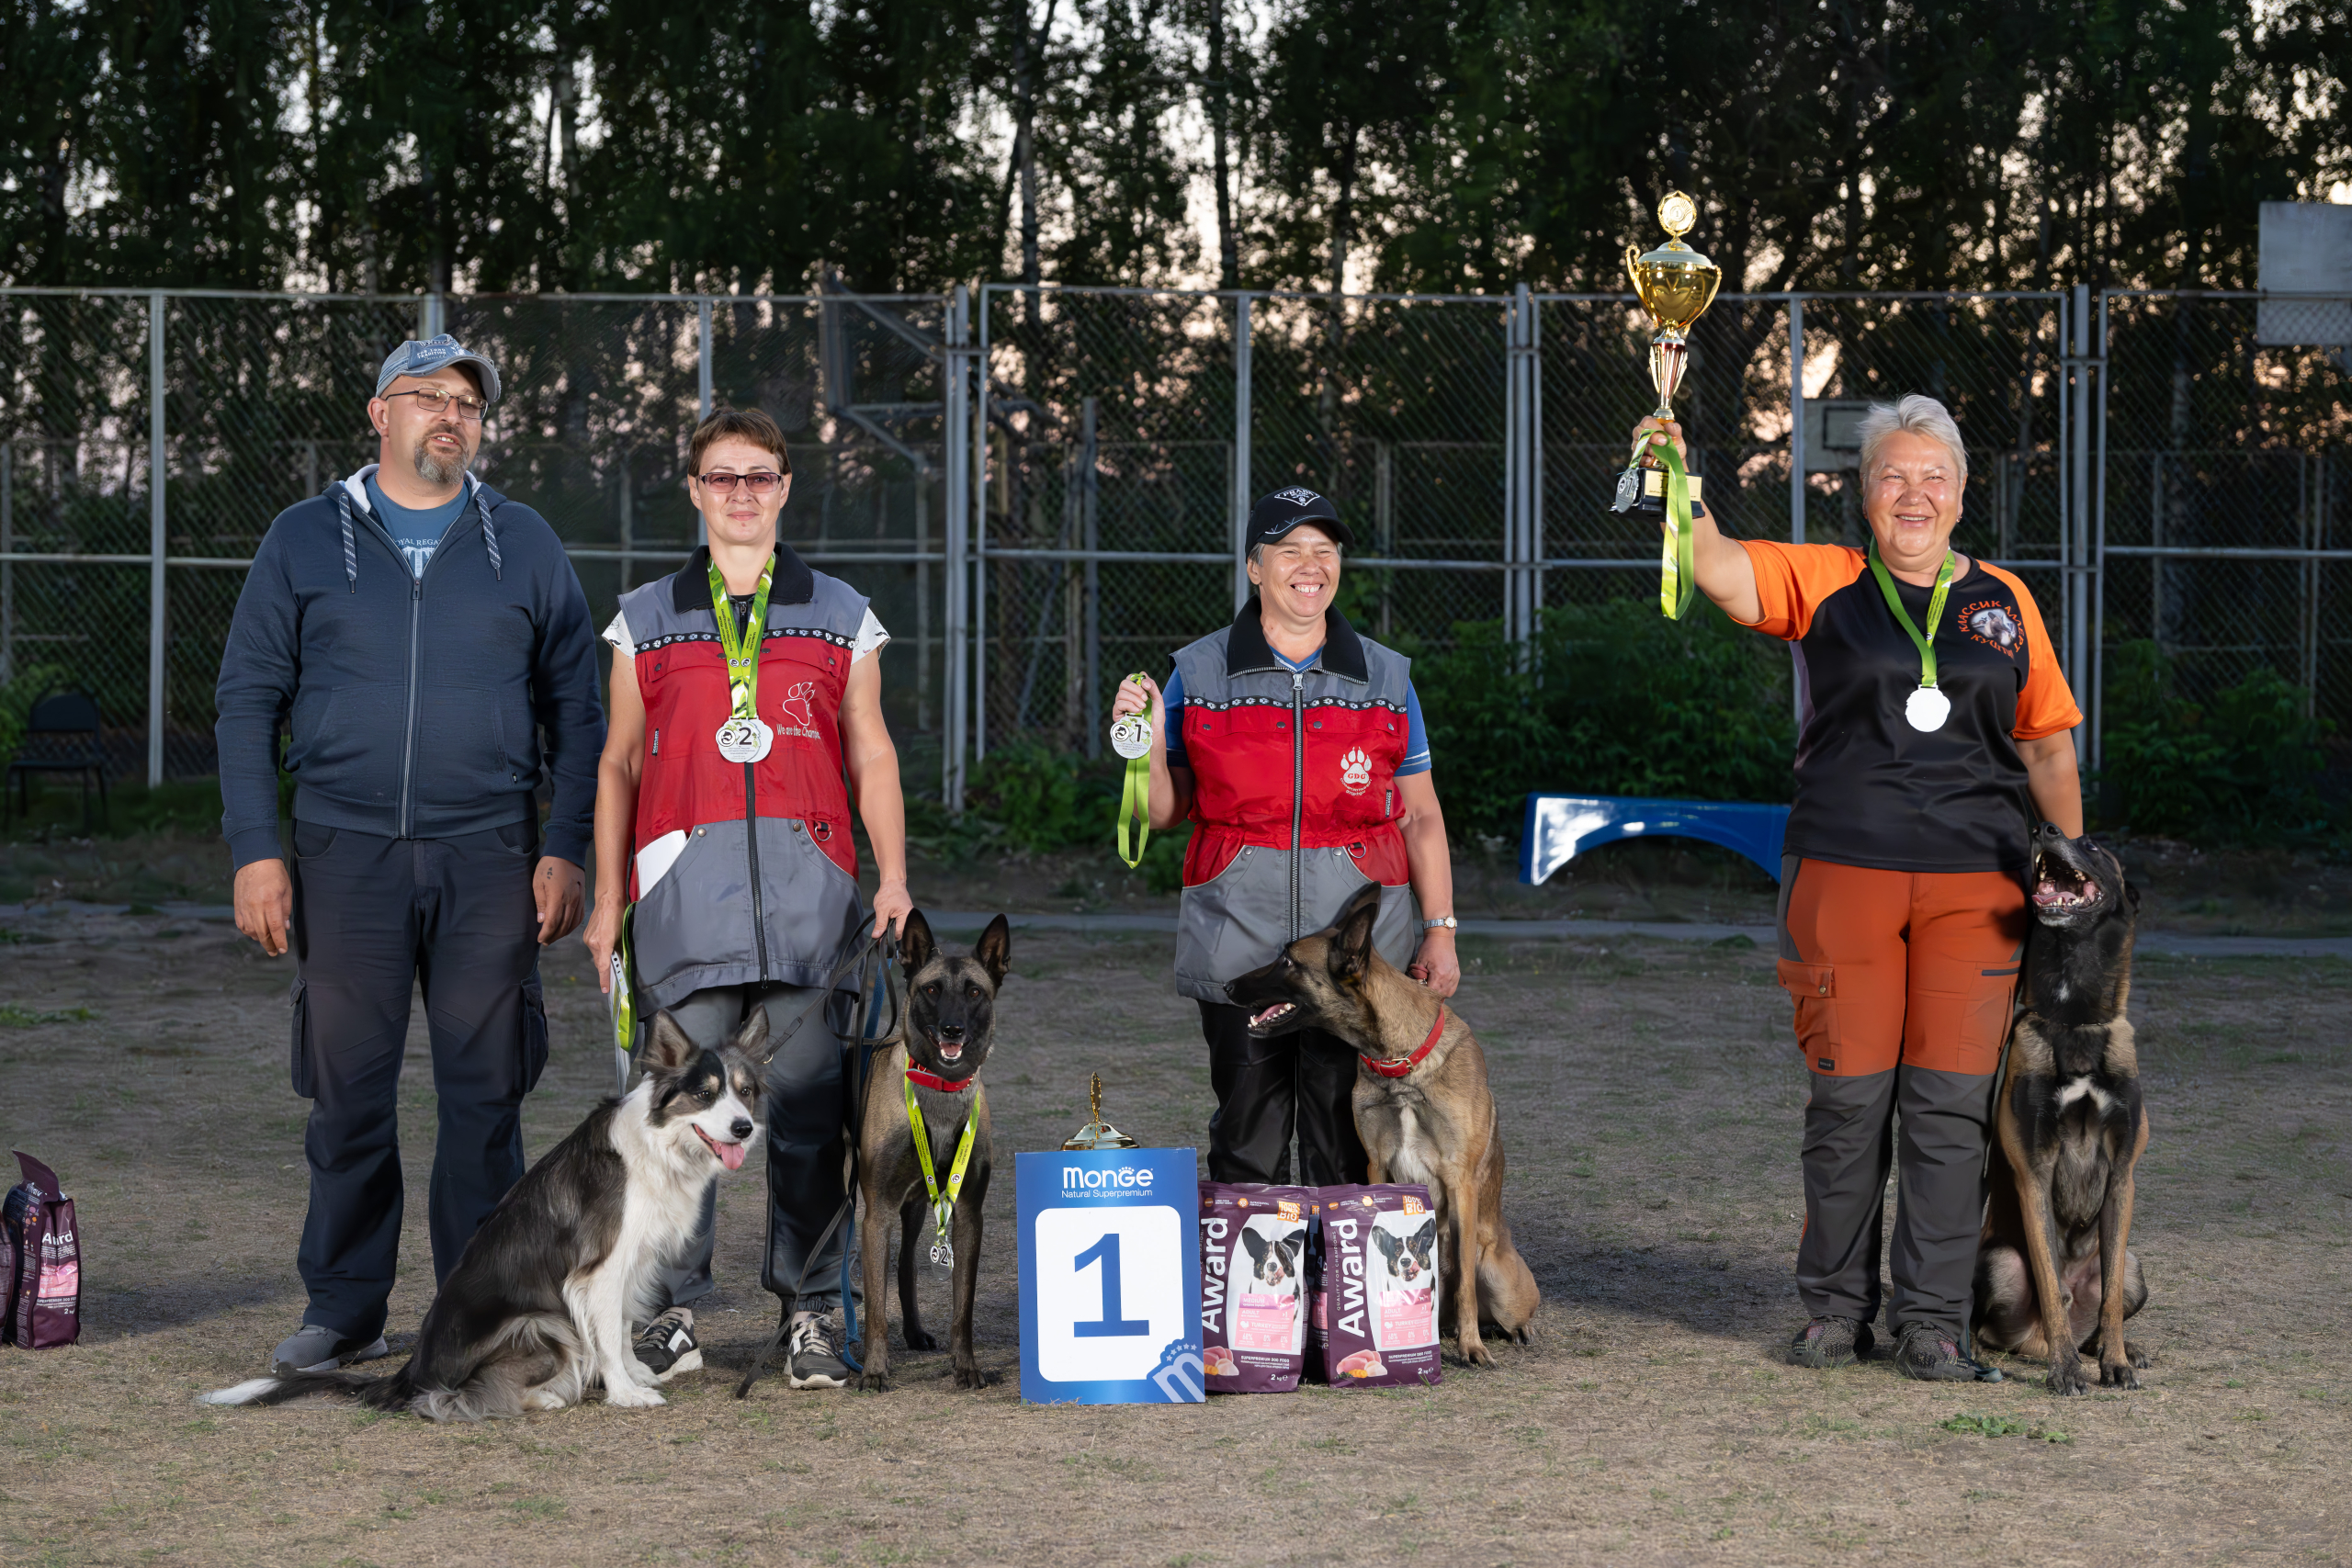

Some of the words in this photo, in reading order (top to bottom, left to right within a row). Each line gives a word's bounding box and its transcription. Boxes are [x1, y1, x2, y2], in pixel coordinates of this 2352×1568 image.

[395, 537, 415, 547] OYAL
[416, 538, 441, 547] REGA
[1958, 600, 2002, 633] КЛАССИК
[739, 727, 752, 746] 2
[776, 723, 786, 736] We
[1134, 724, 1142, 743] 1
[1061, 1190, 1091, 1199] Natural
[1092, 1188, 1153, 1199] Superpremium
[1403, 1195, 1423, 1205] 100%
[1280, 1202, 1299, 1213] 100%
[1405, 1202, 1424, 1214] BIO
[940, 1246, 948, 1265] 2
[1201, 1217, 1228, 1334] Award
[1329, 1218, 1364, 1337] Award
[1074, 1233, 1149, 1337] 1
[1418, 1367, 1423, 1375] 2
